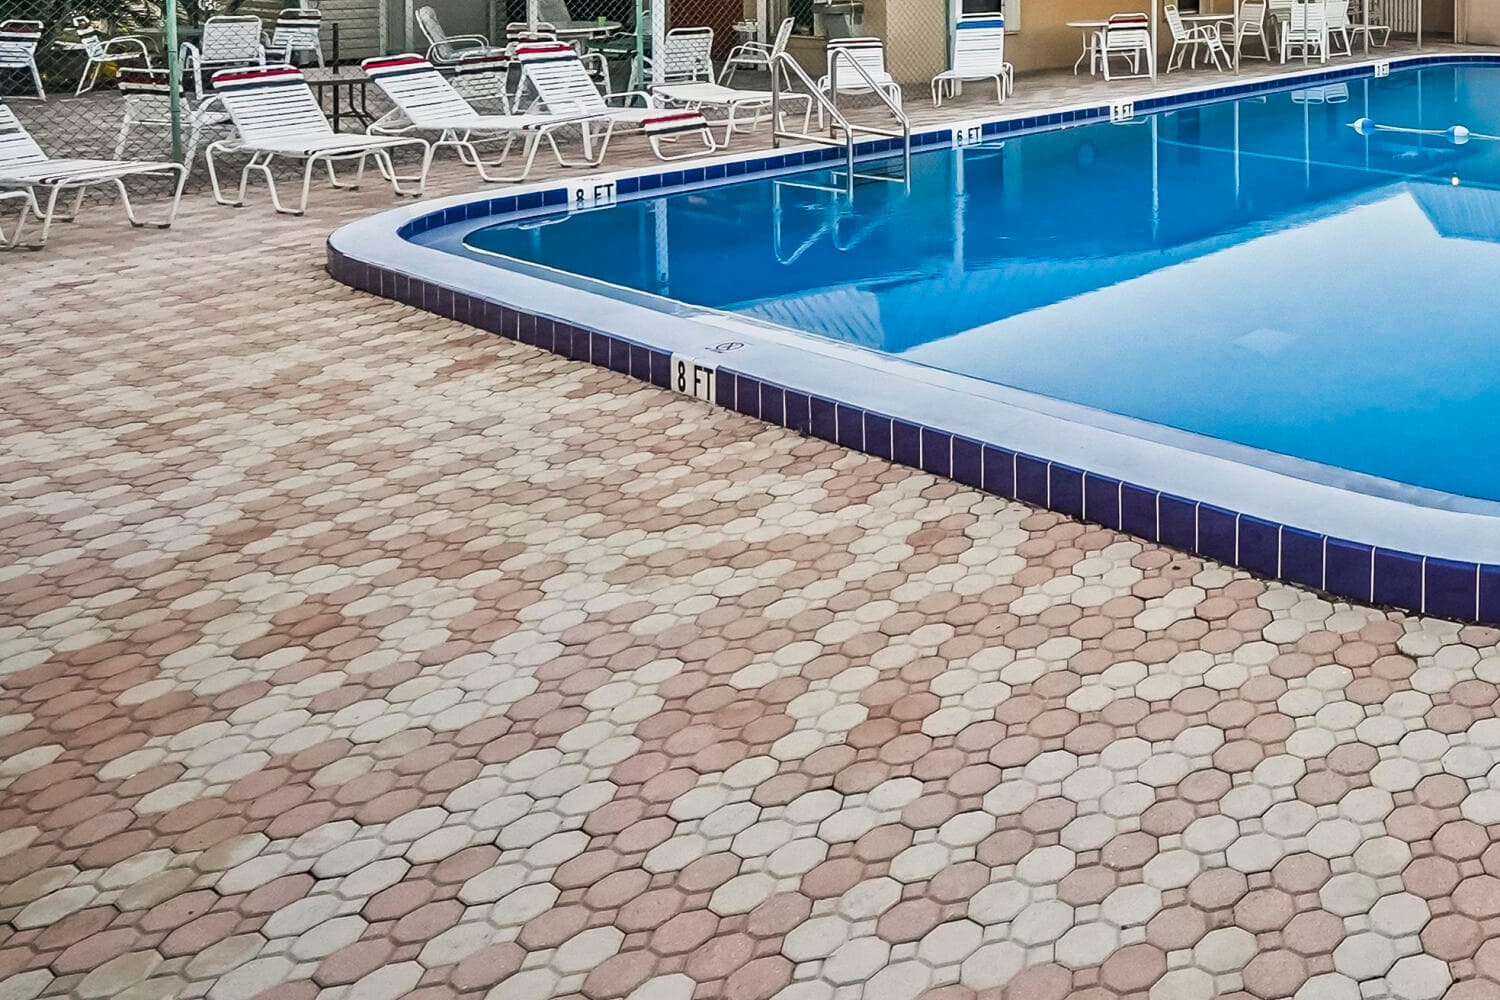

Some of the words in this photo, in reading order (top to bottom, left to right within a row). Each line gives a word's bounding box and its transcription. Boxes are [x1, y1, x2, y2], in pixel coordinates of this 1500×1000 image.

[1122, 104, 1132, 117] FT
[968, 126, 980, 141] FT
[594, 183, 614, 202] FT
[678, 360, 686, 393] 8
[694, 364, 714, 401] FT
